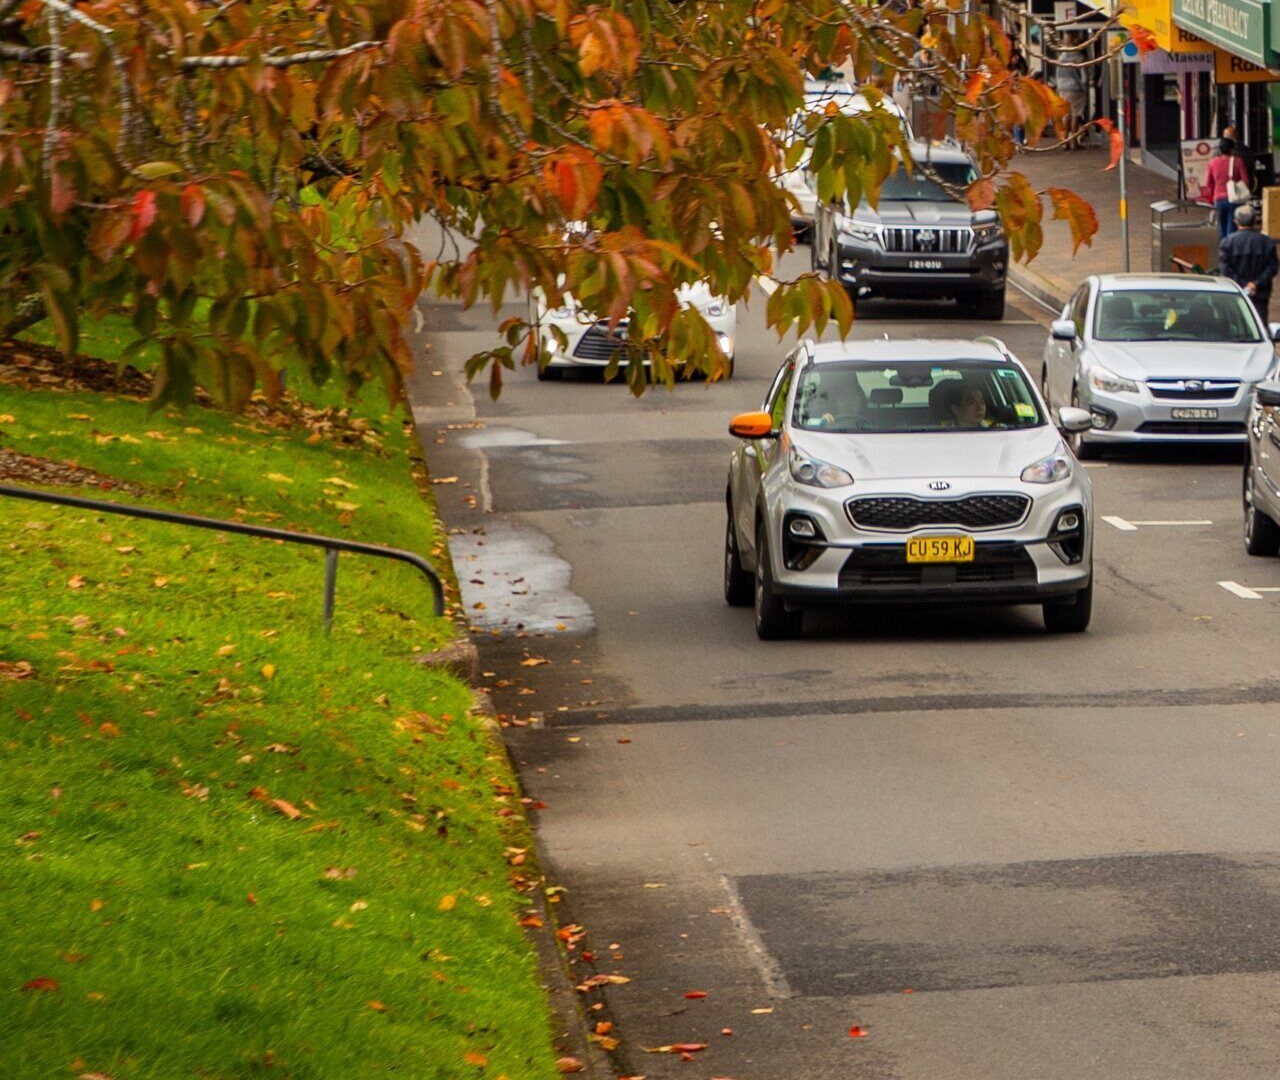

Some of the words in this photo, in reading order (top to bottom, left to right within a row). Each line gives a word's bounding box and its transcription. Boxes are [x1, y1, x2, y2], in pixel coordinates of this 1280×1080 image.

[1166, 51, 1214, 65] Massag
[930, 481, 949, 490] KIA
[909, 541, 927, 556] CU
[931, 541, 949, 556] 59
[953, 541, 971, 557] KJ
